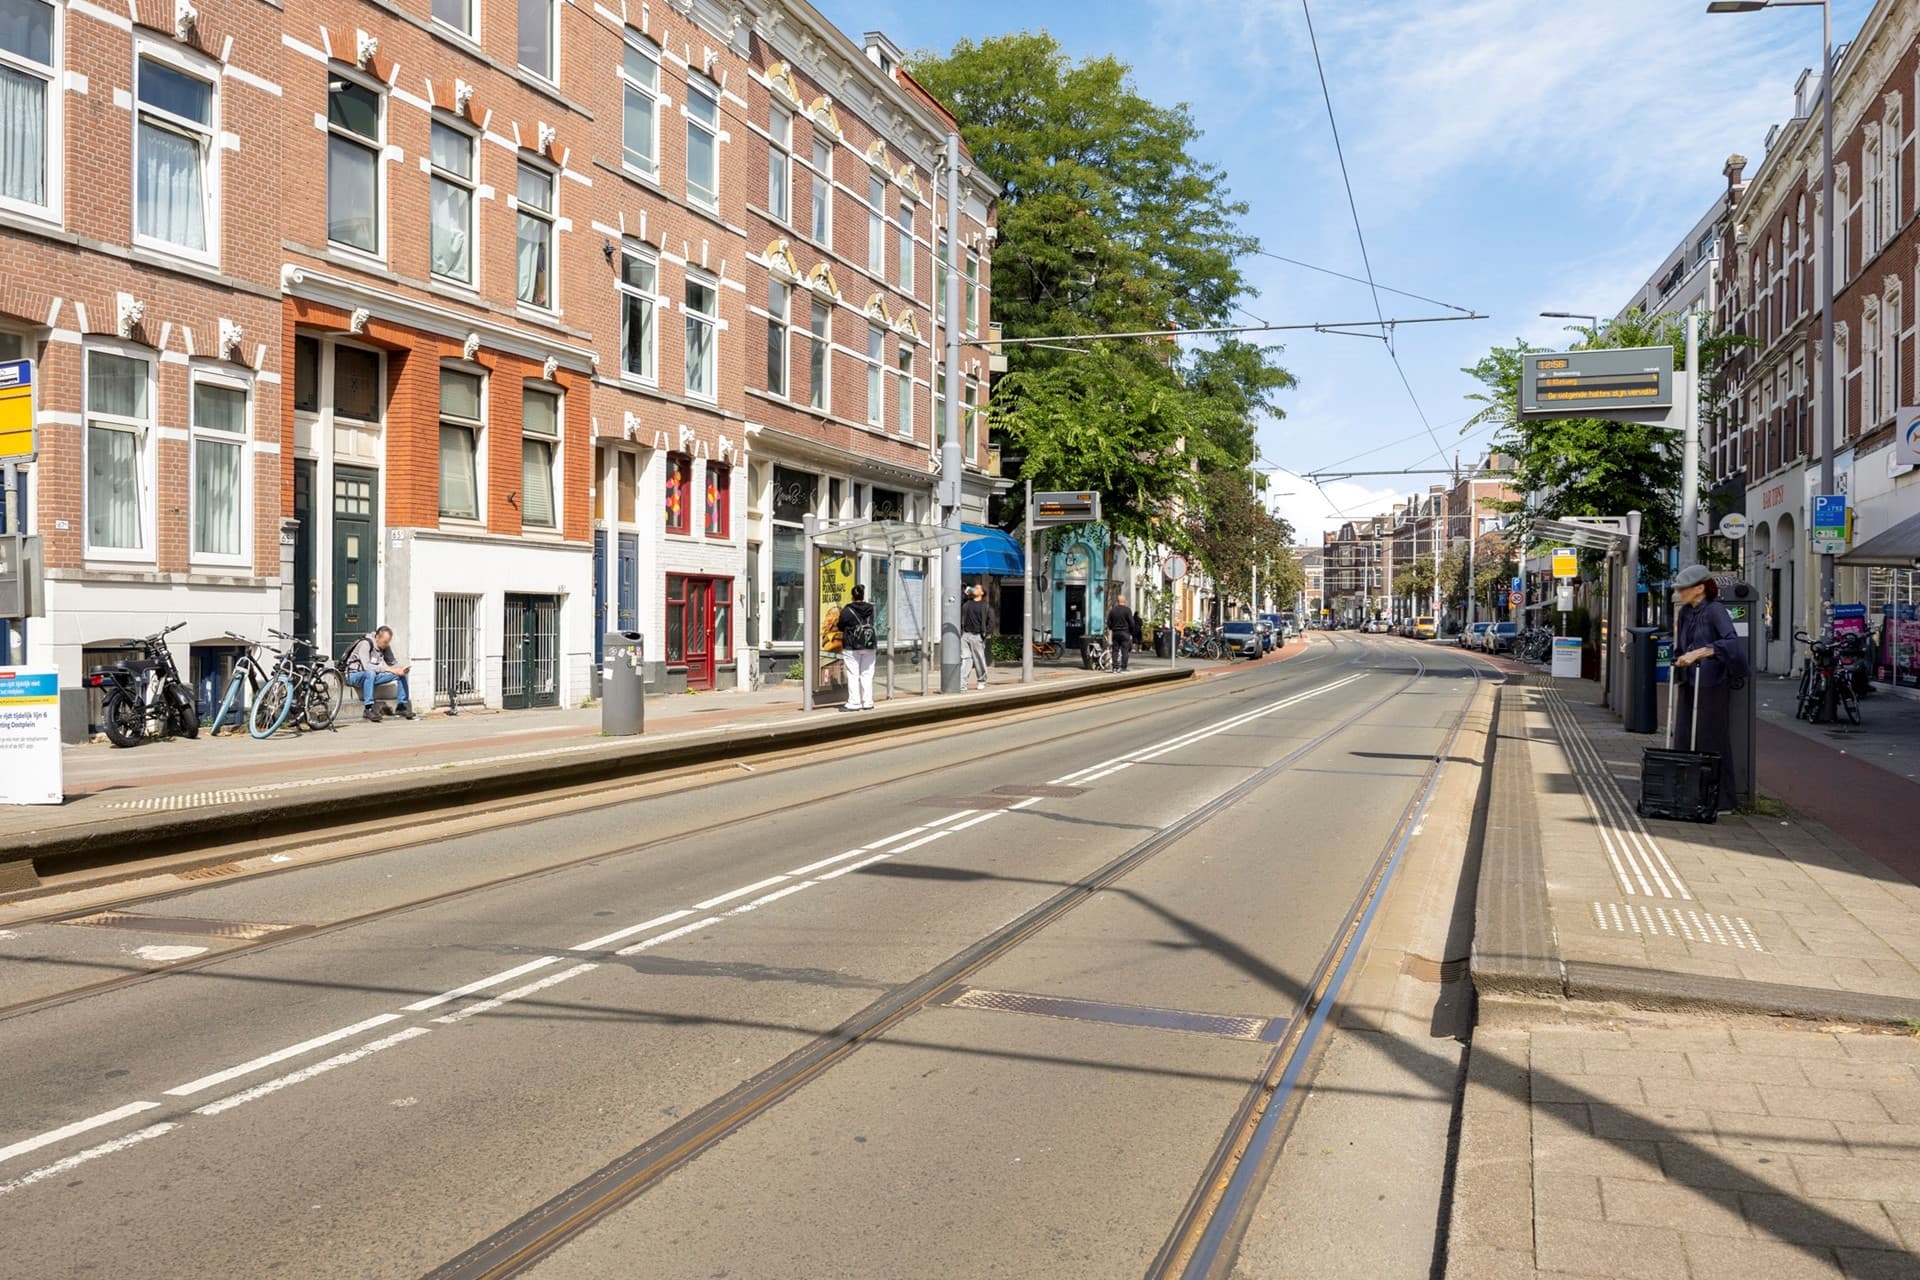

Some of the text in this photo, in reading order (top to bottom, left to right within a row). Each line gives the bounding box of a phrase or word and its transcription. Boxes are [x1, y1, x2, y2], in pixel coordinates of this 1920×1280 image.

[1816, 497, 1827, 511] P
[14, 711, 32, 720] tijdelijk
[33, 711, 42, 720] lijn
